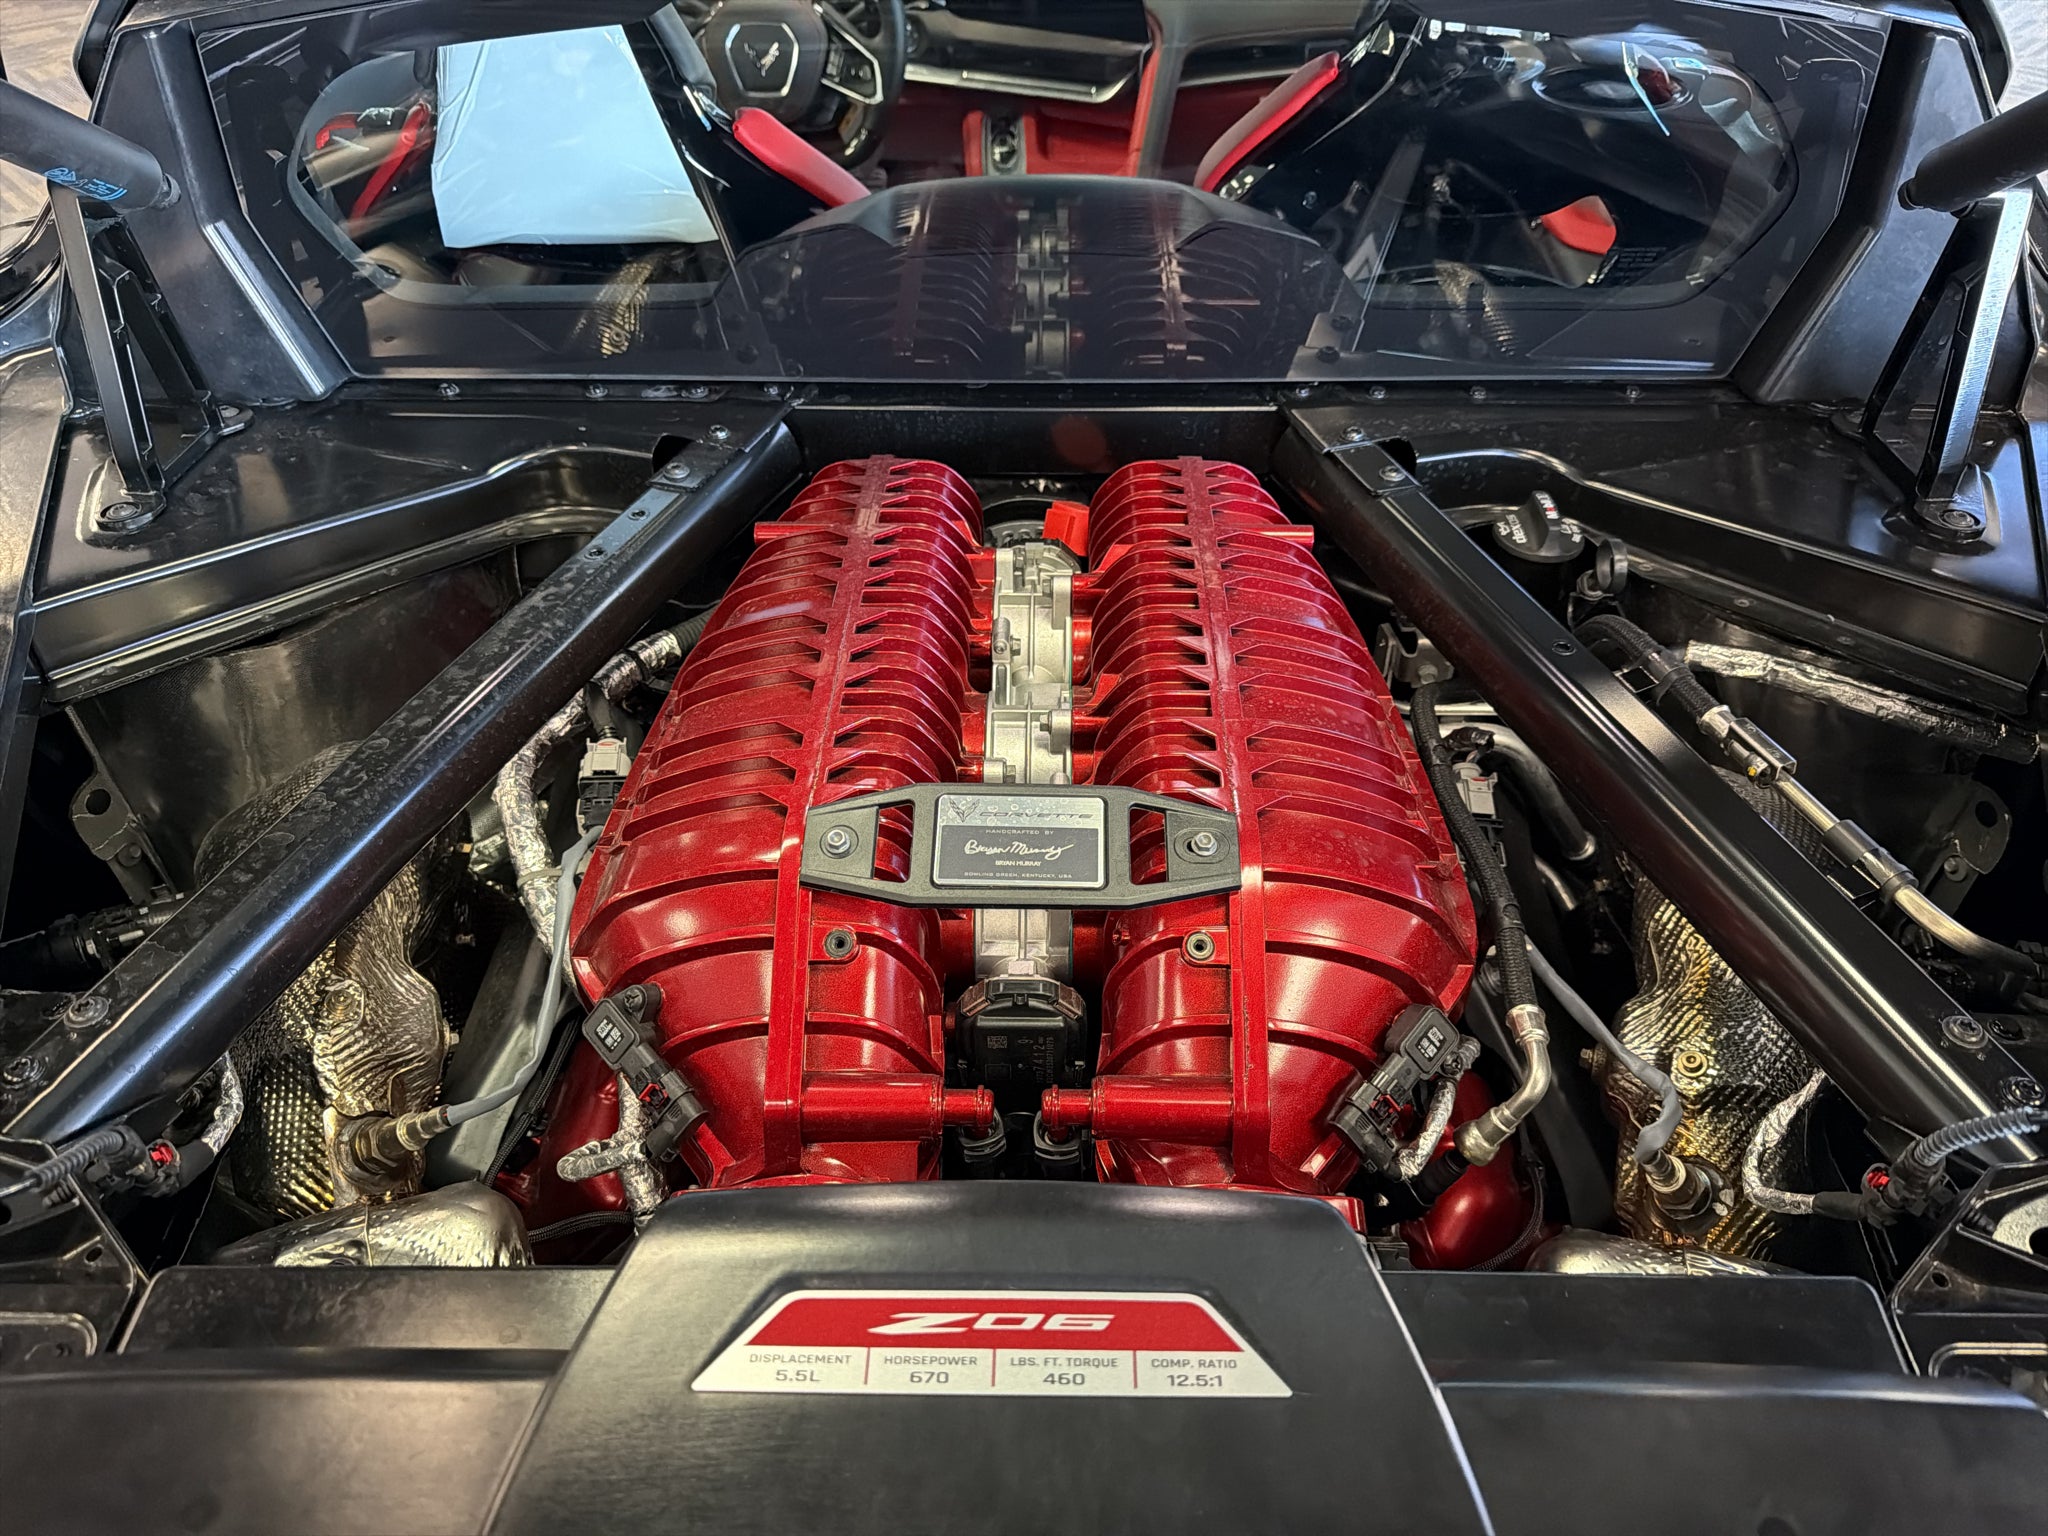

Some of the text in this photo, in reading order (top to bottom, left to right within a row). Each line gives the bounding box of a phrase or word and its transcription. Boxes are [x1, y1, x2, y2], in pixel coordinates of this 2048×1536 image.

[1505, 513, 1528, 544] dexos
[866, 1312, 1116, 1336] Z06
[749, 1353, 852, 1366] DISPLACEMENT
[884, 1354, 978, 1366] HORSEPOWER
[1010, 1357, 1119, 1369] LBS. FT. TORQUE
[1151, 1358, 1238, 1369] COMP. RATIO
[775, 1369, 822, 1382] 5.5L
[909, 1371, 950, 1384] 670
[1042, 1372, 1086, 1386] 460
[1166, 1373, 1224, 1387] 12.5:1
